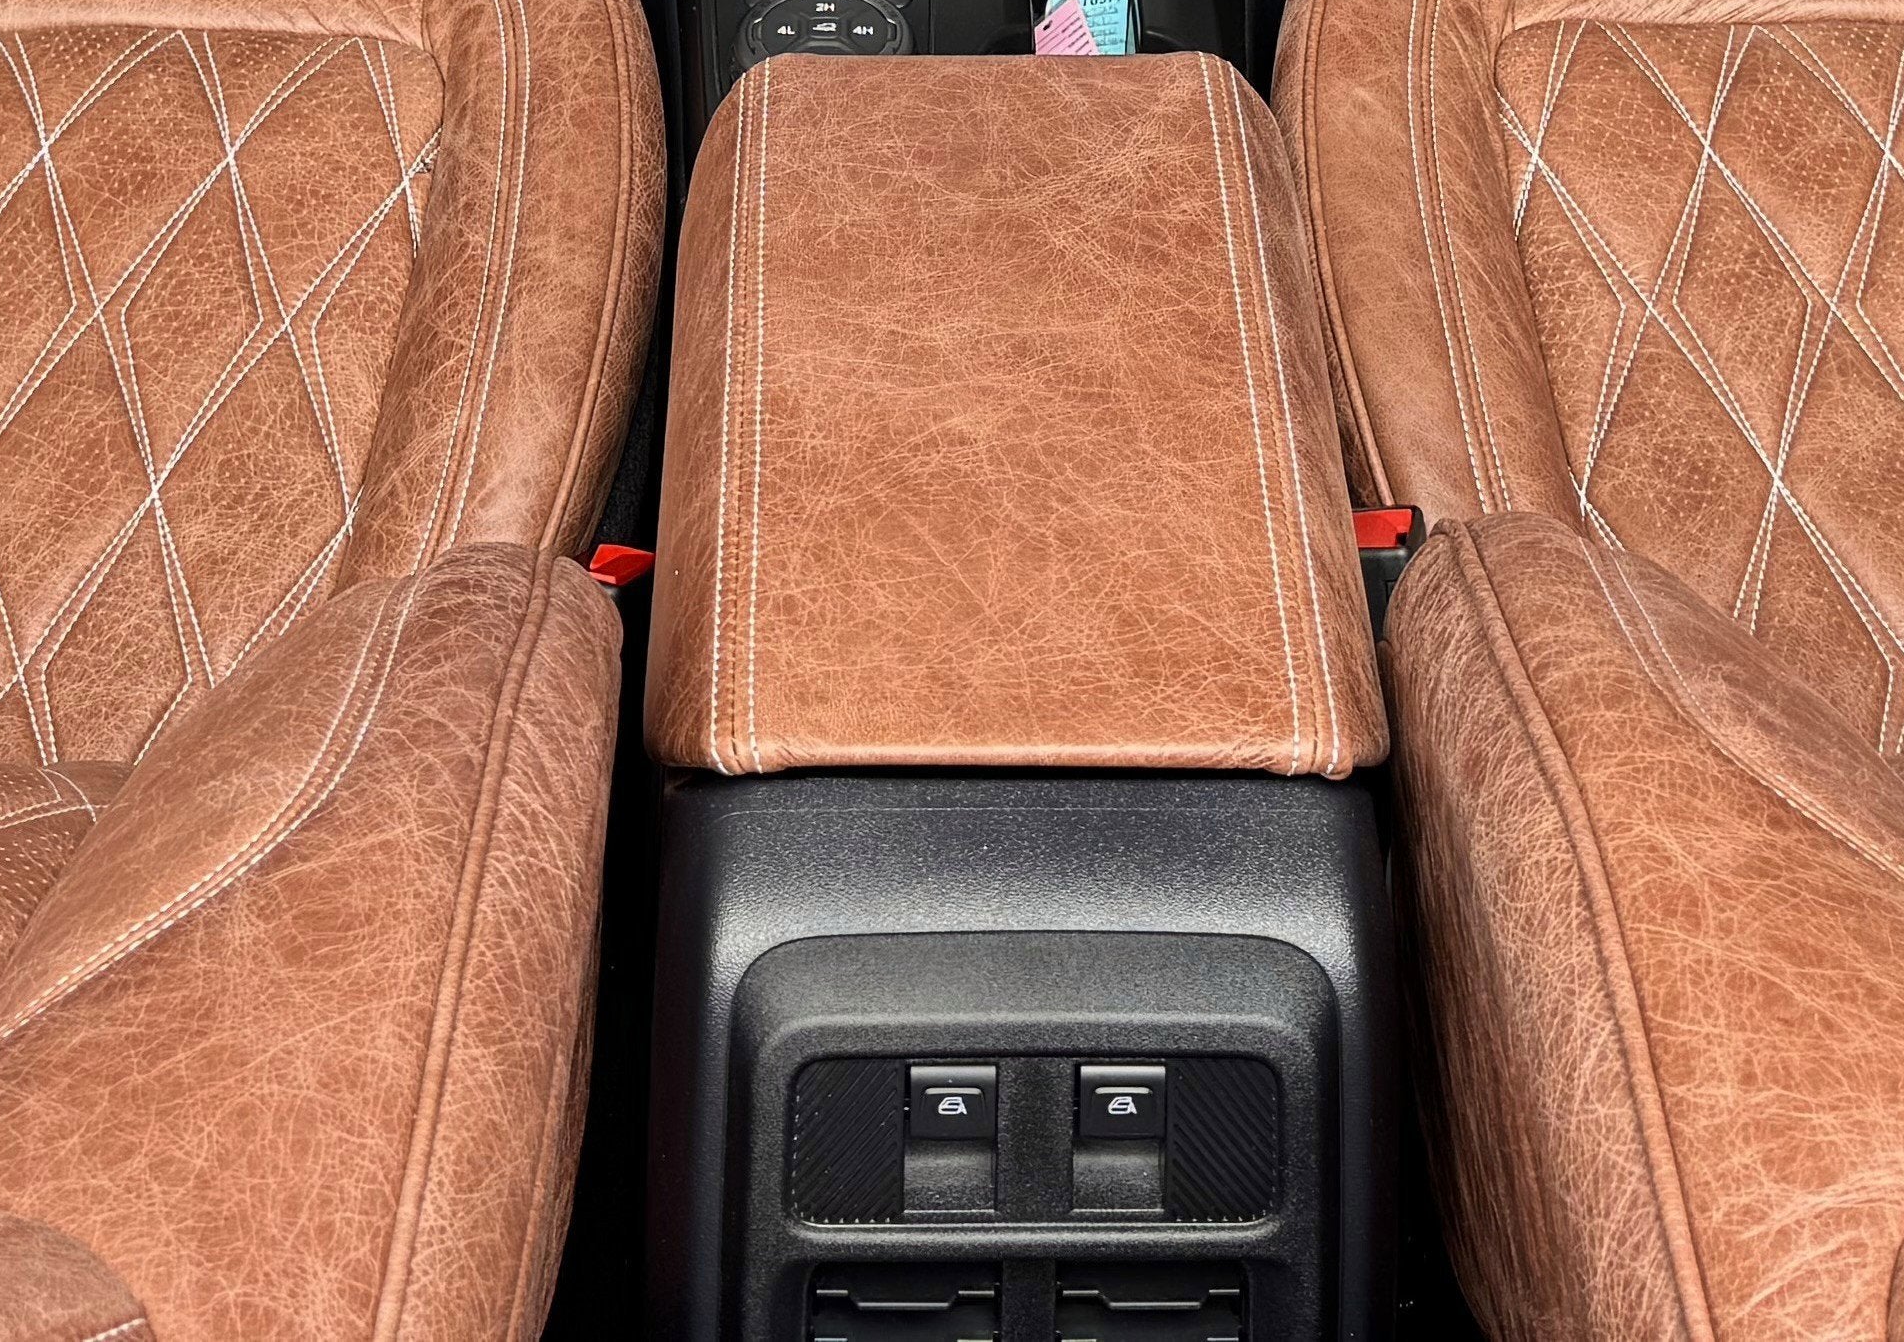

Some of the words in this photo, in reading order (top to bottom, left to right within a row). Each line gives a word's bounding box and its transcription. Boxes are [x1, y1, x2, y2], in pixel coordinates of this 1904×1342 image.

[815, 3, 835, 12] 2H
[777, 26, 796, 35] 4L
[852, 26, 874, 35] 4H
